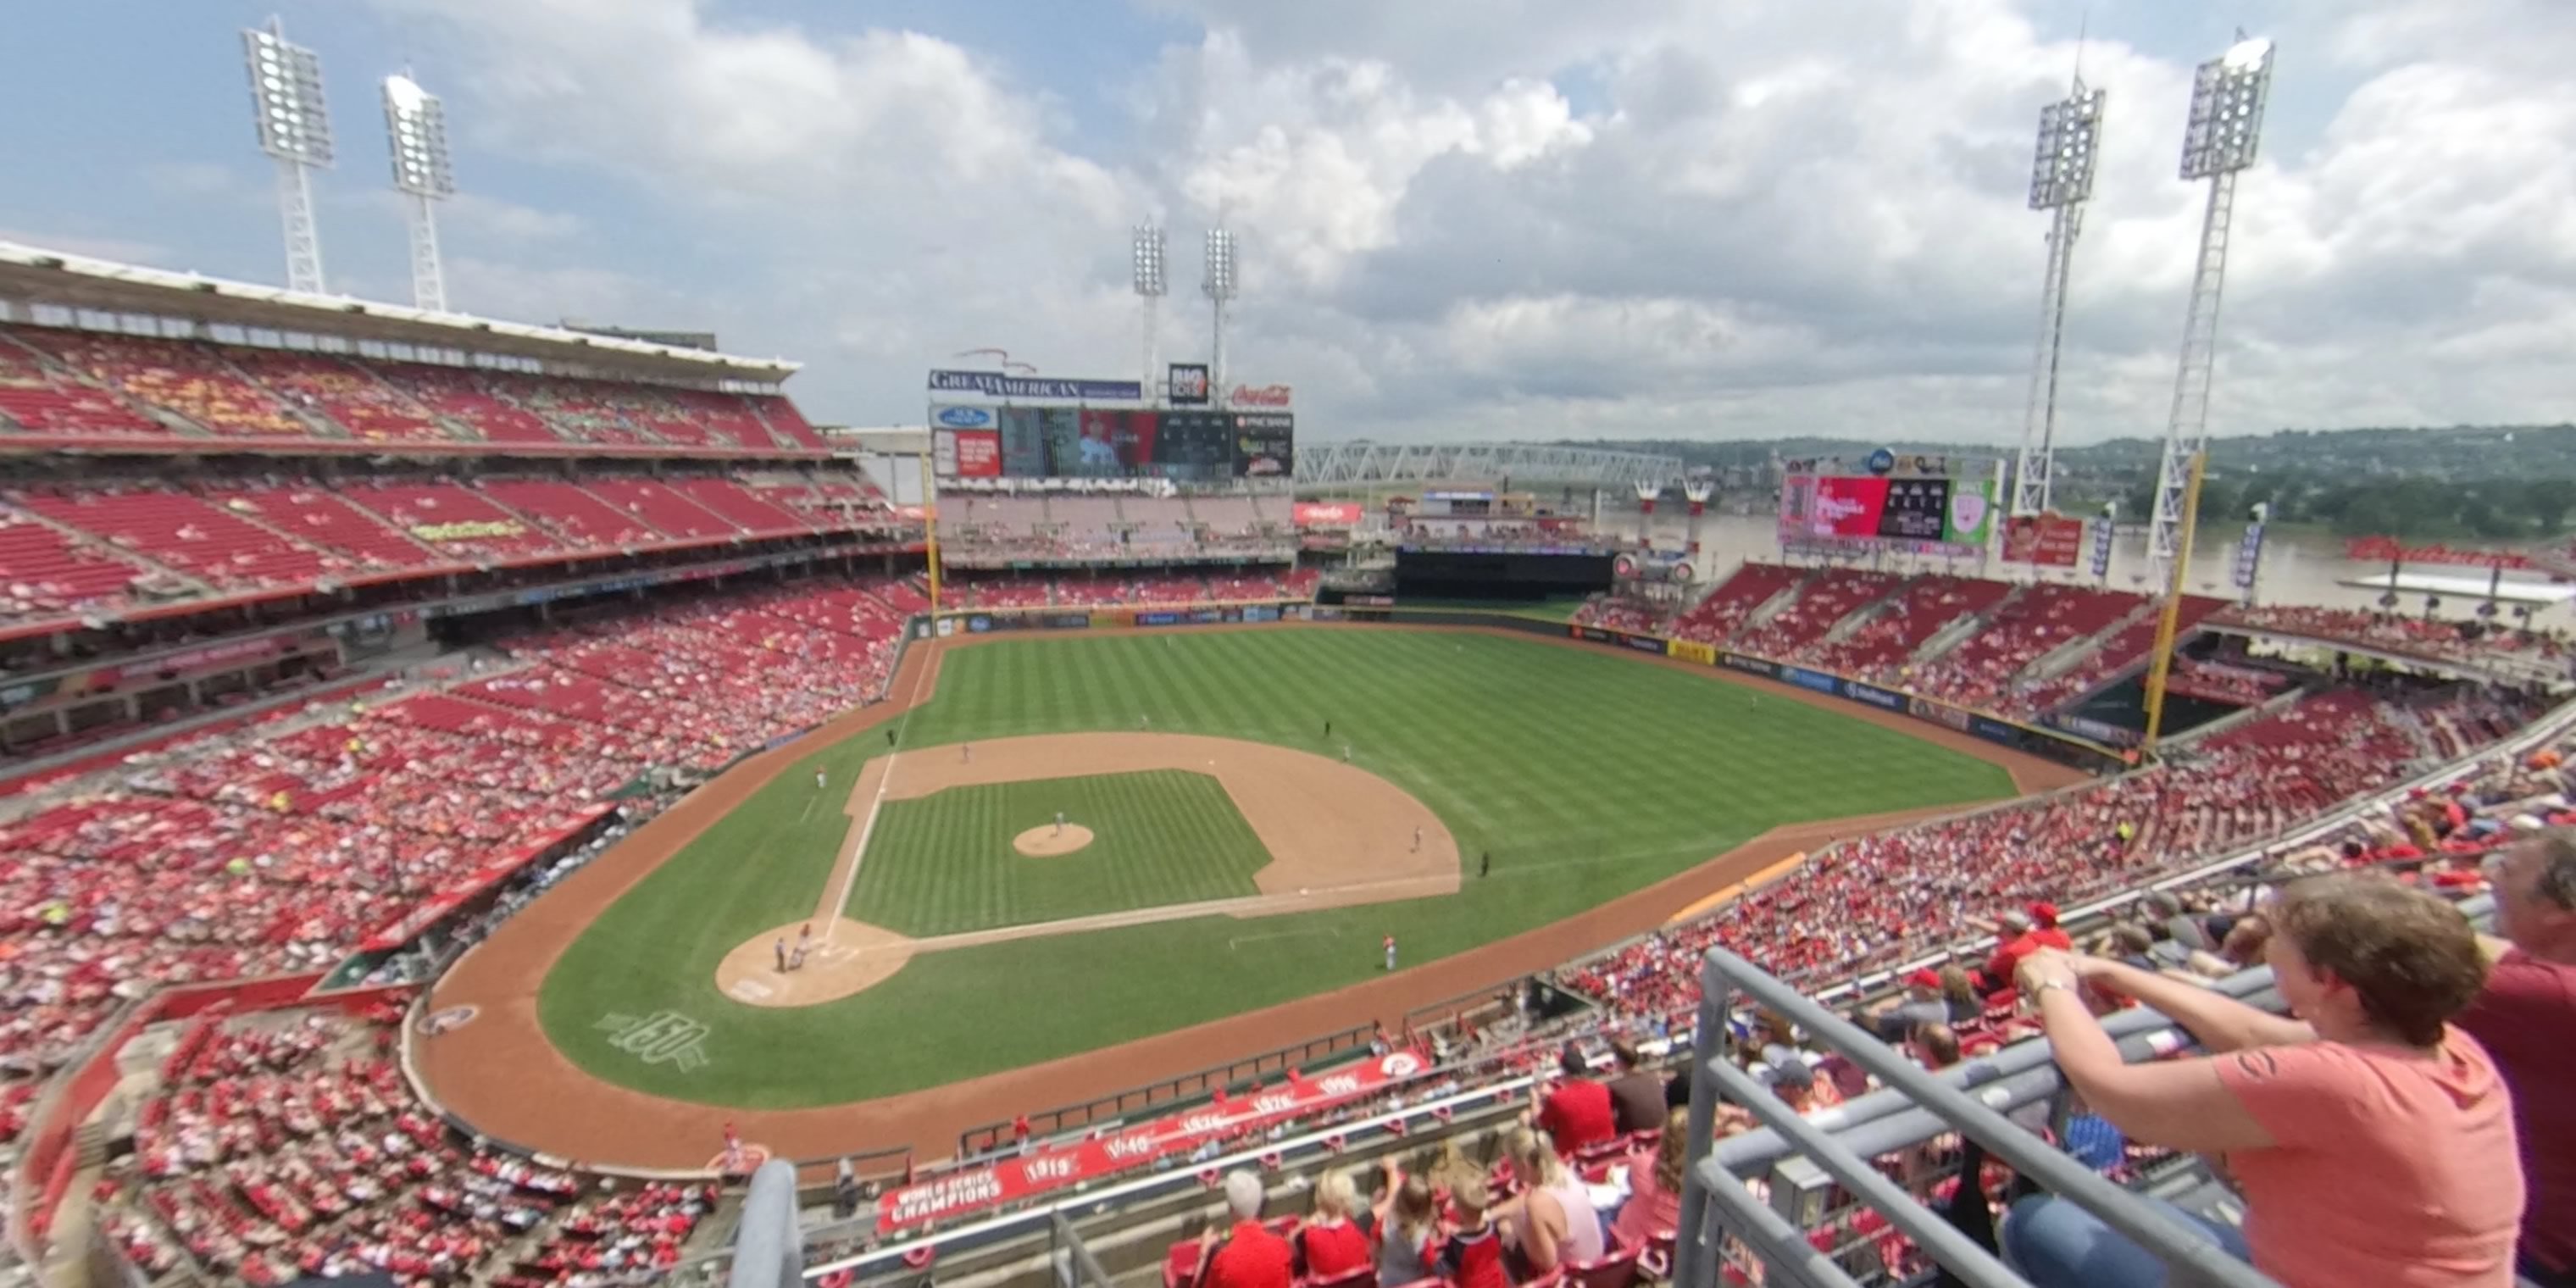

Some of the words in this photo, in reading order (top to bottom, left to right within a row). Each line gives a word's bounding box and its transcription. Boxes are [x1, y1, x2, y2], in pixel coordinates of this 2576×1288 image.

[931, 371, 997, 391] GREAT
[993, 378, 1080, 397] AMERICAN
[1171, 368, 1206, 383] BIG
[1026, 1158, 1069, 1182] 1919
[898, 1181, 945, 1205] WORLD
[947, 1169, 995, 1193] SERIES
[891, 1180, 1002, 1223] CHAMPIONS
